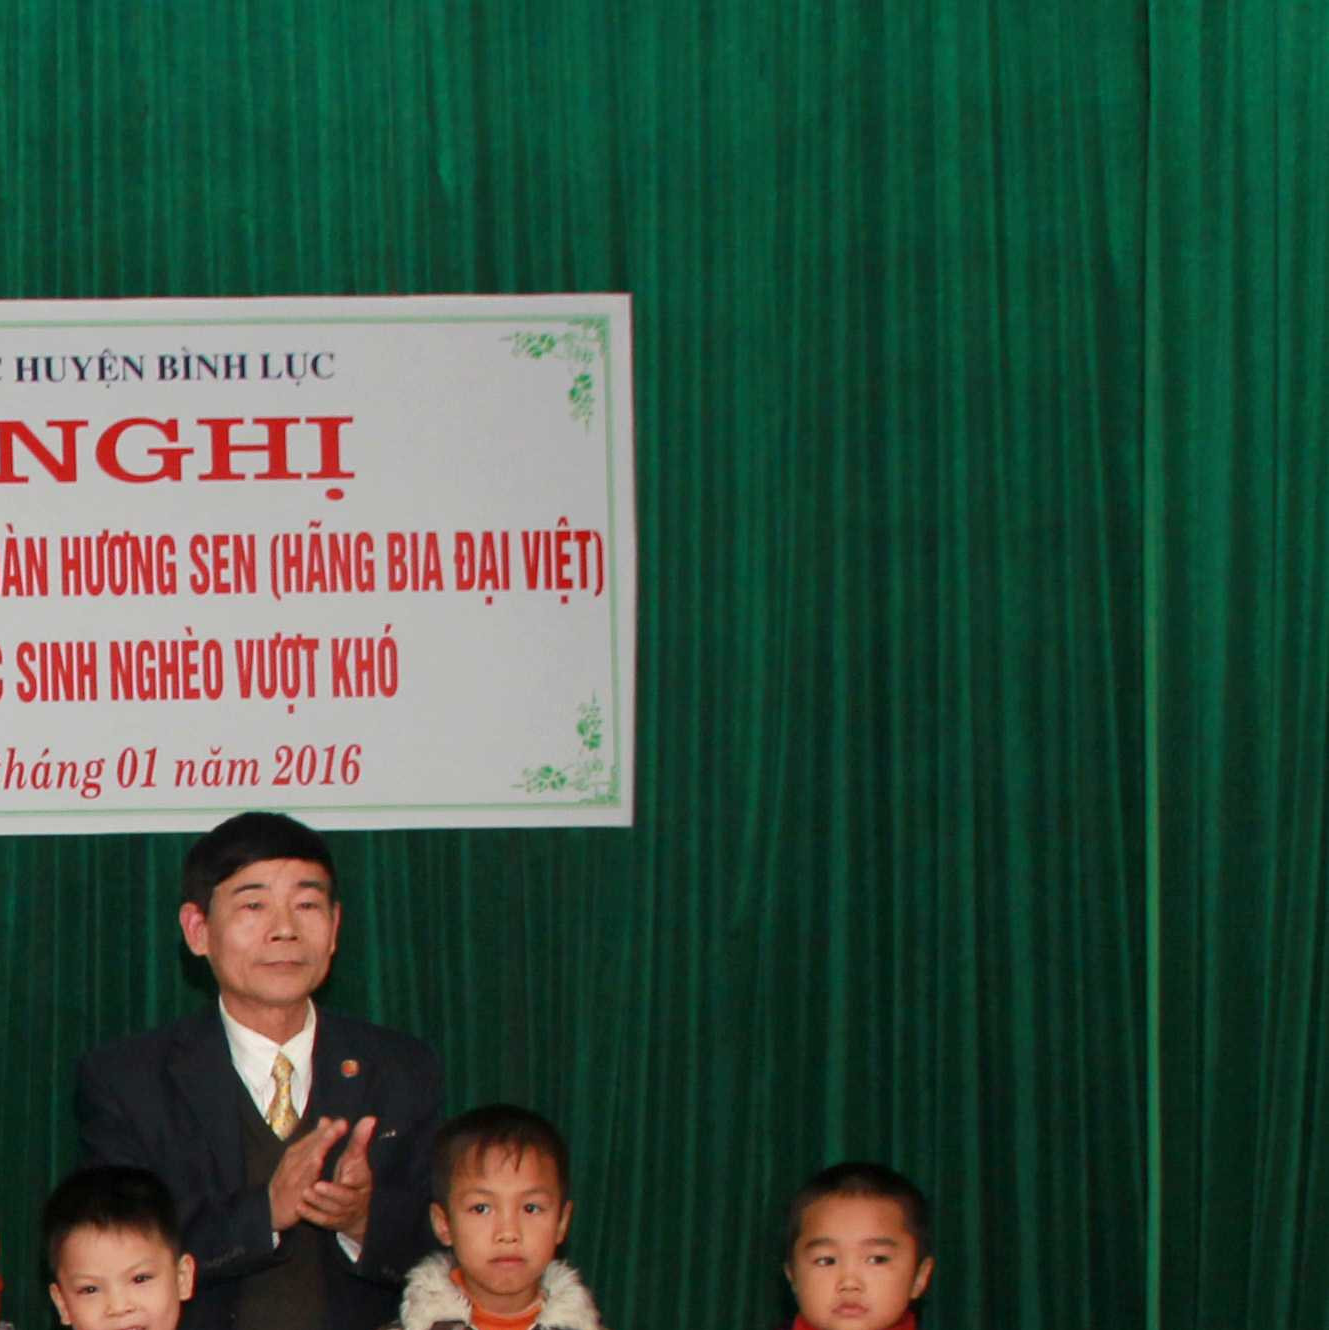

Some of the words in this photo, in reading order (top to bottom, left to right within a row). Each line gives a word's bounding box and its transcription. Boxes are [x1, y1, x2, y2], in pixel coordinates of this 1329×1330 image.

[17, 349, 143, 388] HUYỆN
[159, 352, 245, 380] BÌNH
[262, 354, 333, 386] LỤC
[61, 529, 177, 597] HƯƠNG
[189, 534, 257, 595] SEN
[270, 520, 376, 599] (HÃNG
[387, 531, 443, 592] BIA
[454, 530, 511, 605] ĐẠI
[521, 516, 605, 604] VIỆT)
[16, 640, 98, 704] SINH
[109, 628, 224, 702] NGHÈO
[234, 632, 320, 714] VƯỢT
[331, 624, 399, 698] KHÓ
[117, 747, 157, 790] 01
[175, 748, 259, 788] năm
[272, 744, 362, 787] 2016
